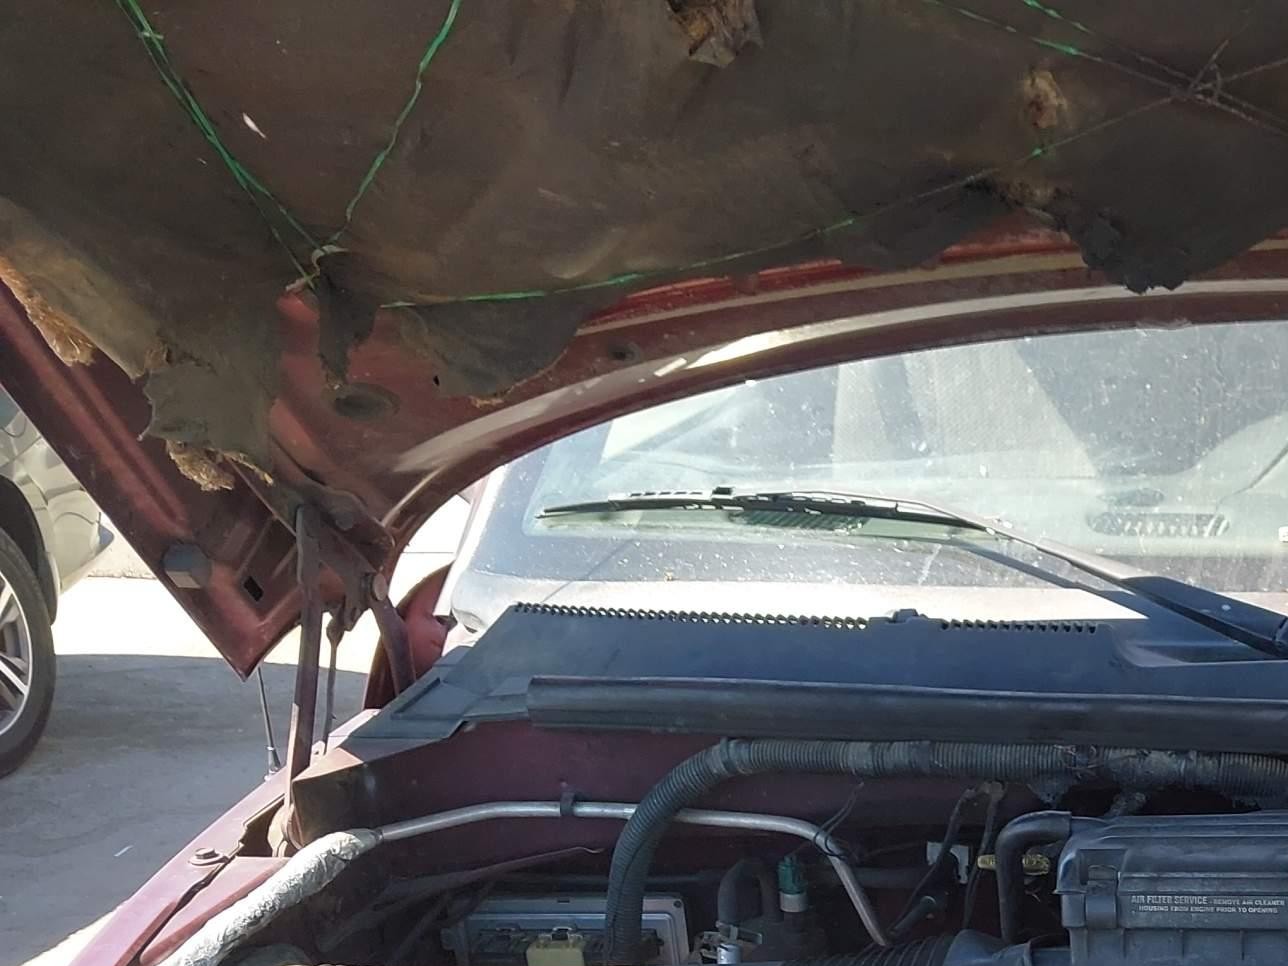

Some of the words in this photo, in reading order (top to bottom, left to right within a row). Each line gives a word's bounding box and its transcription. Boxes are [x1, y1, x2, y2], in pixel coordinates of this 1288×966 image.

[1131, 895, 1146, 904] AIR
[1147, 895, 1172, 905] FILTER
[1174, 895, 1208, 905] SERVICE
